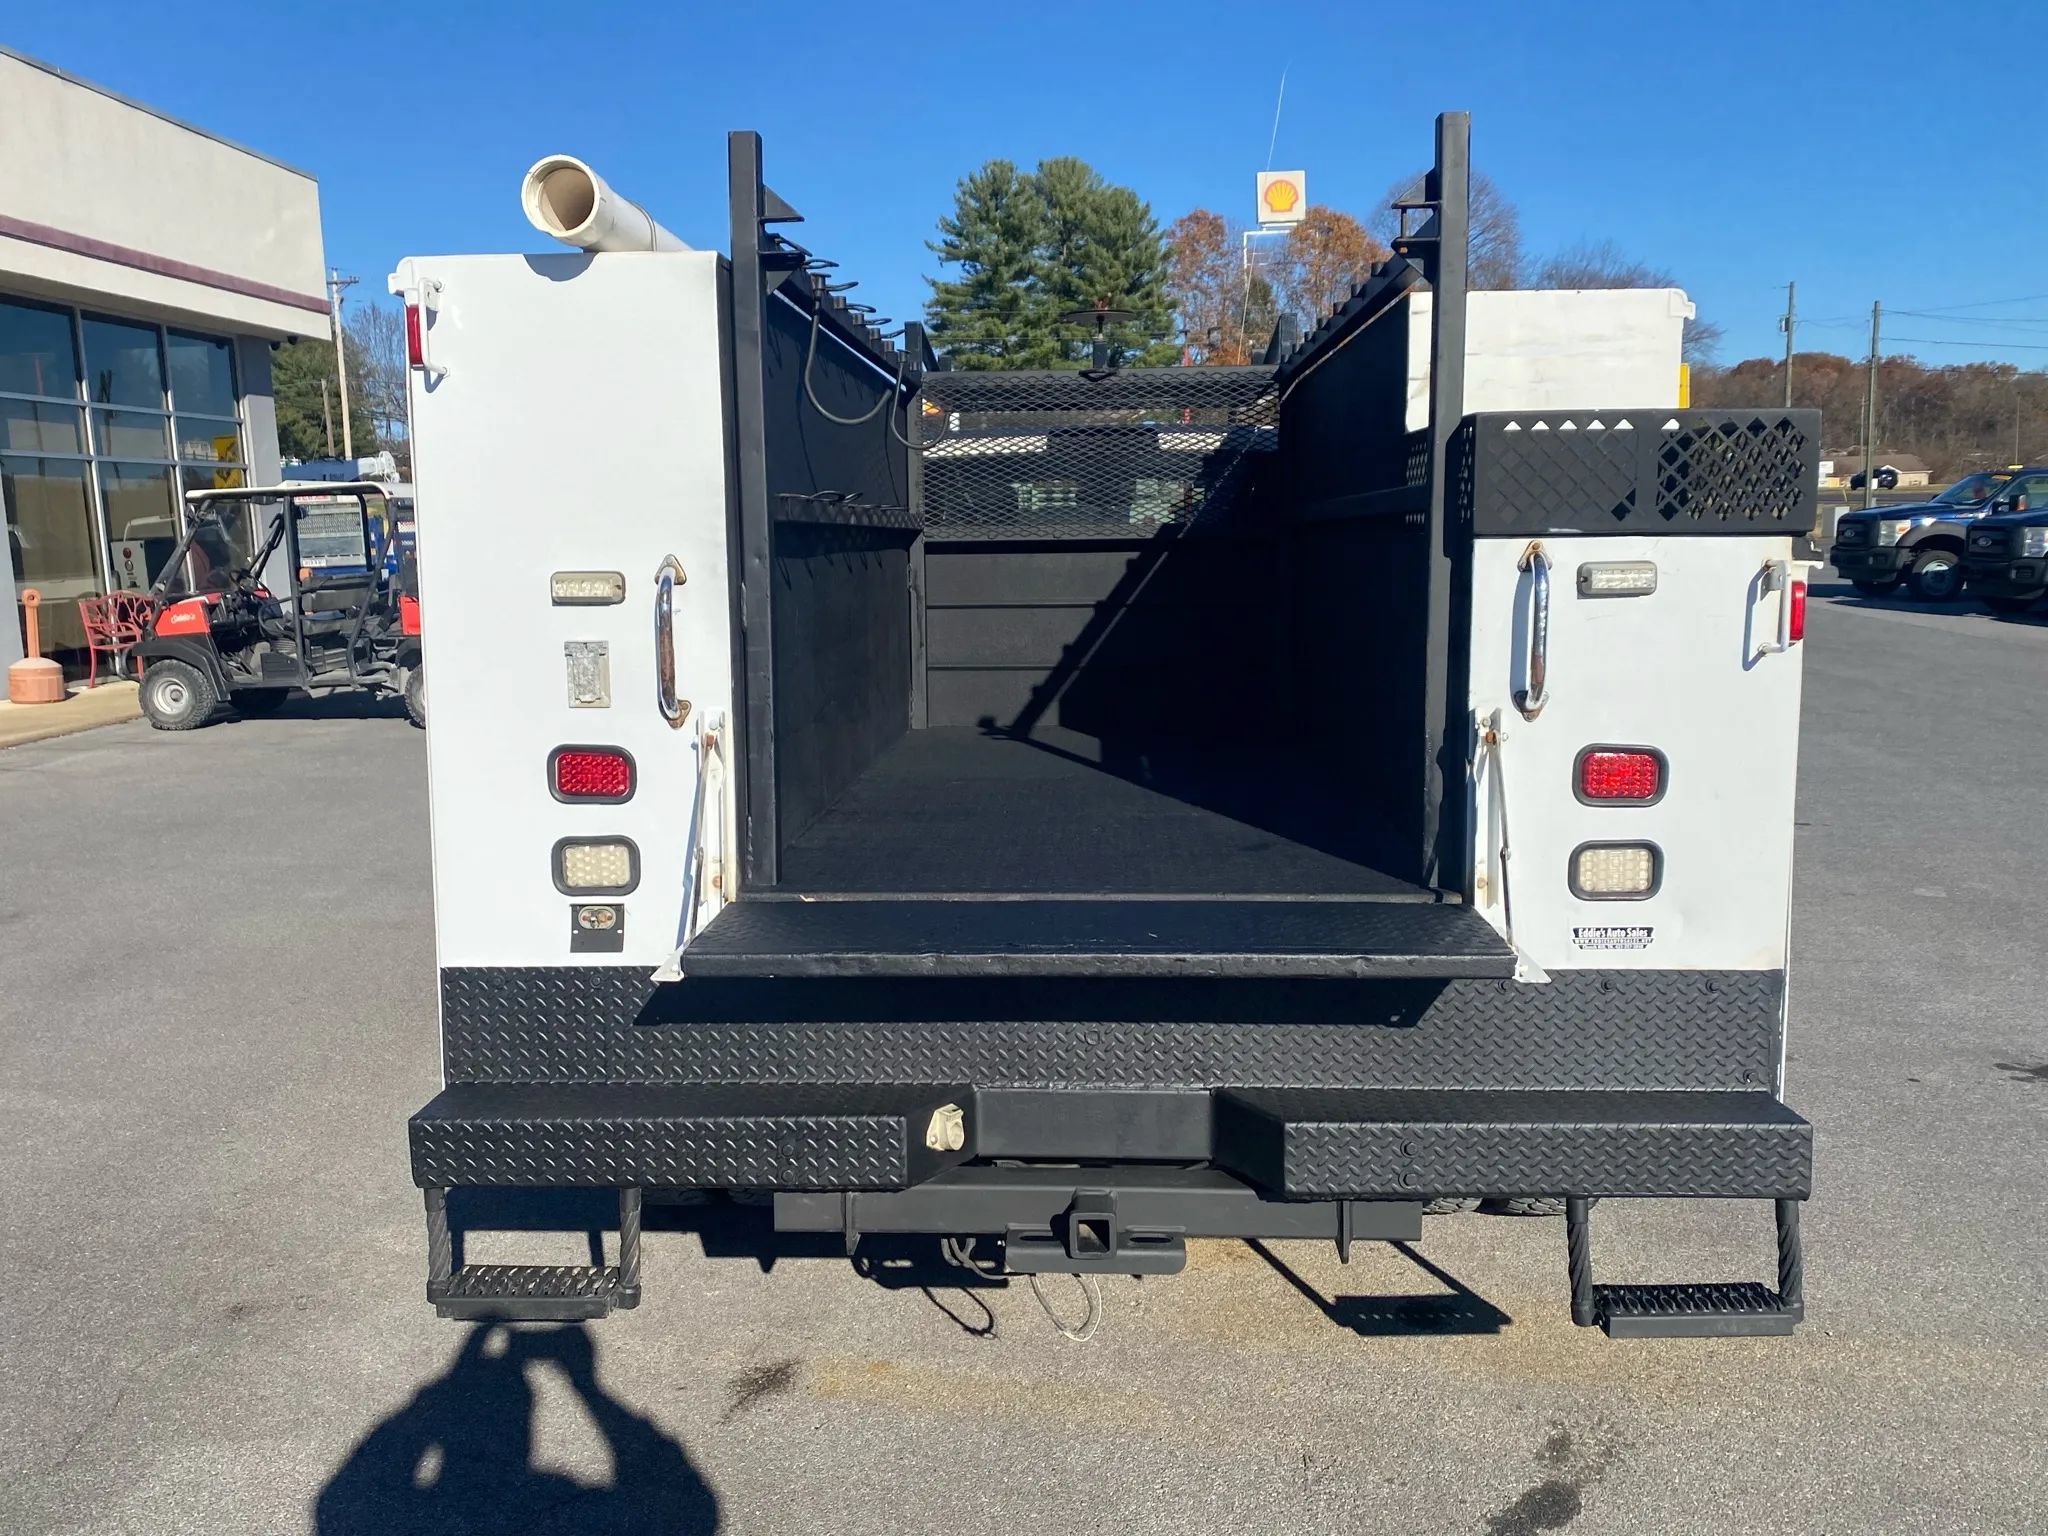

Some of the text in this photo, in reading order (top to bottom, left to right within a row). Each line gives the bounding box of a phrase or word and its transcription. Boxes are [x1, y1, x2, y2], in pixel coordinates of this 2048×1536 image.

[1578, 927, 1648, 938] Eddie's Auto Sales
